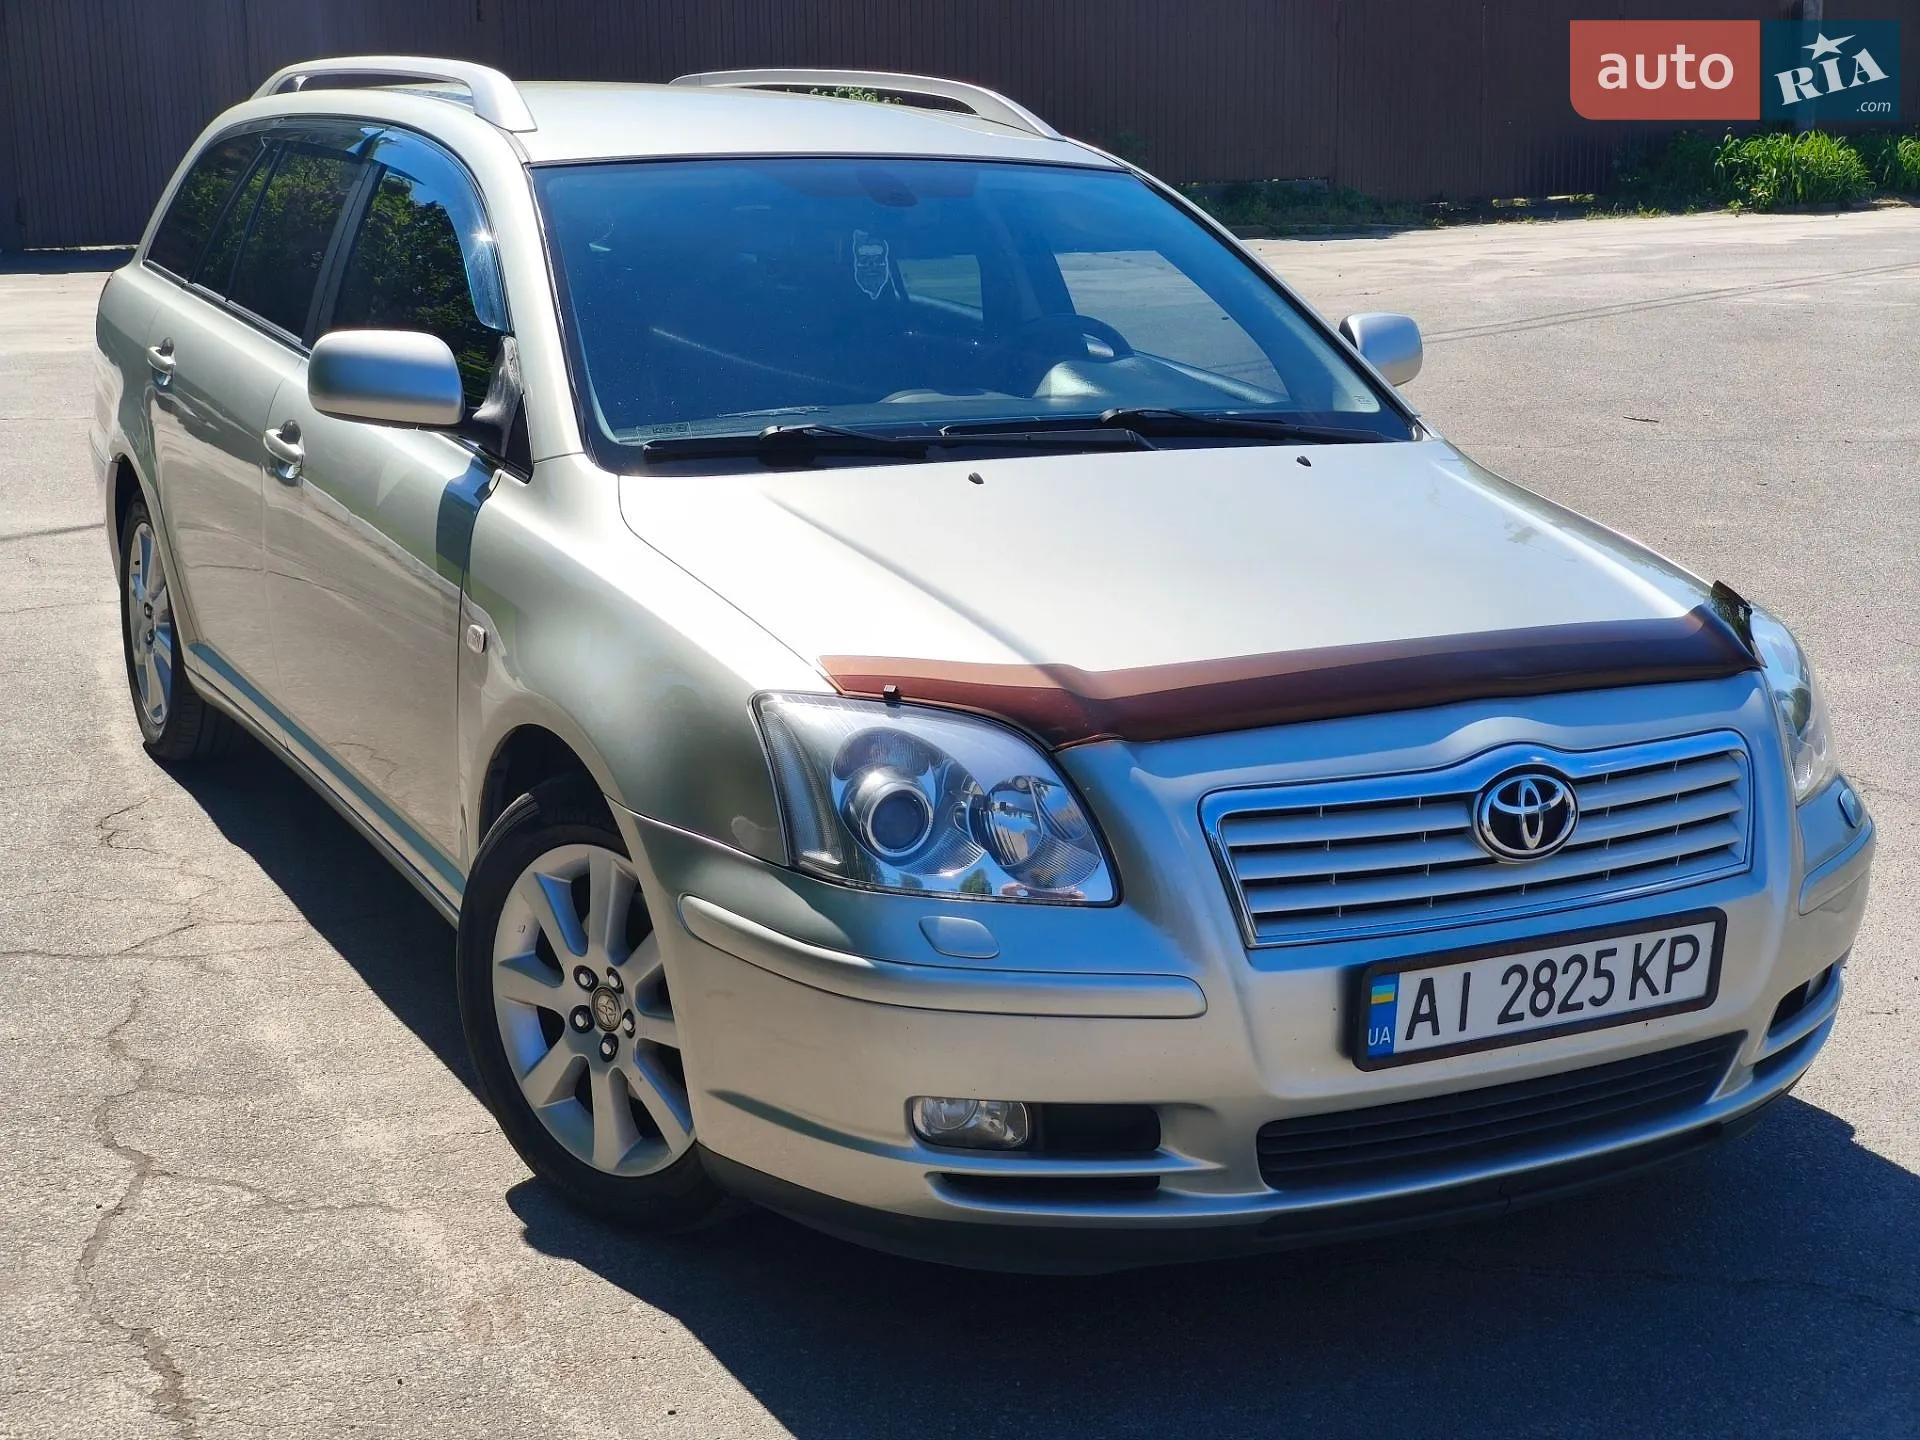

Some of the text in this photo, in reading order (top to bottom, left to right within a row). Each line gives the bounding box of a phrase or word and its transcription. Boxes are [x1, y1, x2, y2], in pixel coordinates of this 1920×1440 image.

[1405, 934, 1700, 1041] AI 2825 KP
[1367, 1027, 1391, 1046] UA
